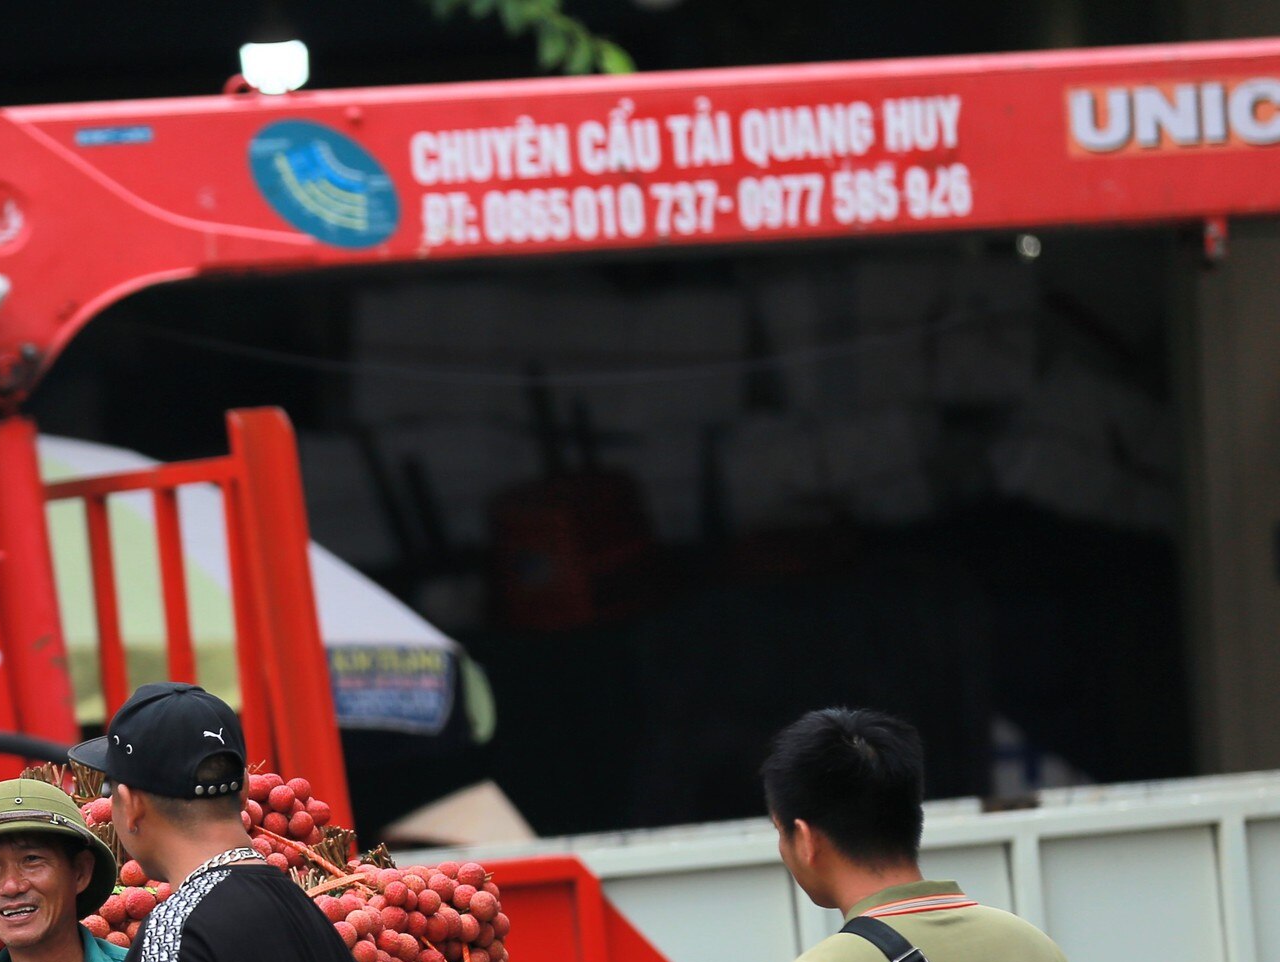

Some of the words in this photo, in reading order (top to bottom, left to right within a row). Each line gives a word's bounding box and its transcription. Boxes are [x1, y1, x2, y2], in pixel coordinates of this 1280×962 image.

[410, 115, 572, 186] CHUYÊN
[577, 97, 662, 175] CẨU
[666, 95, 733, 169] TẢI
[740, 101, 875, 168] QUANG
[883, 94, 961, 153] HUY
[737, 172, 825, 231] 0977
[904, 162, 973, 219] 926
